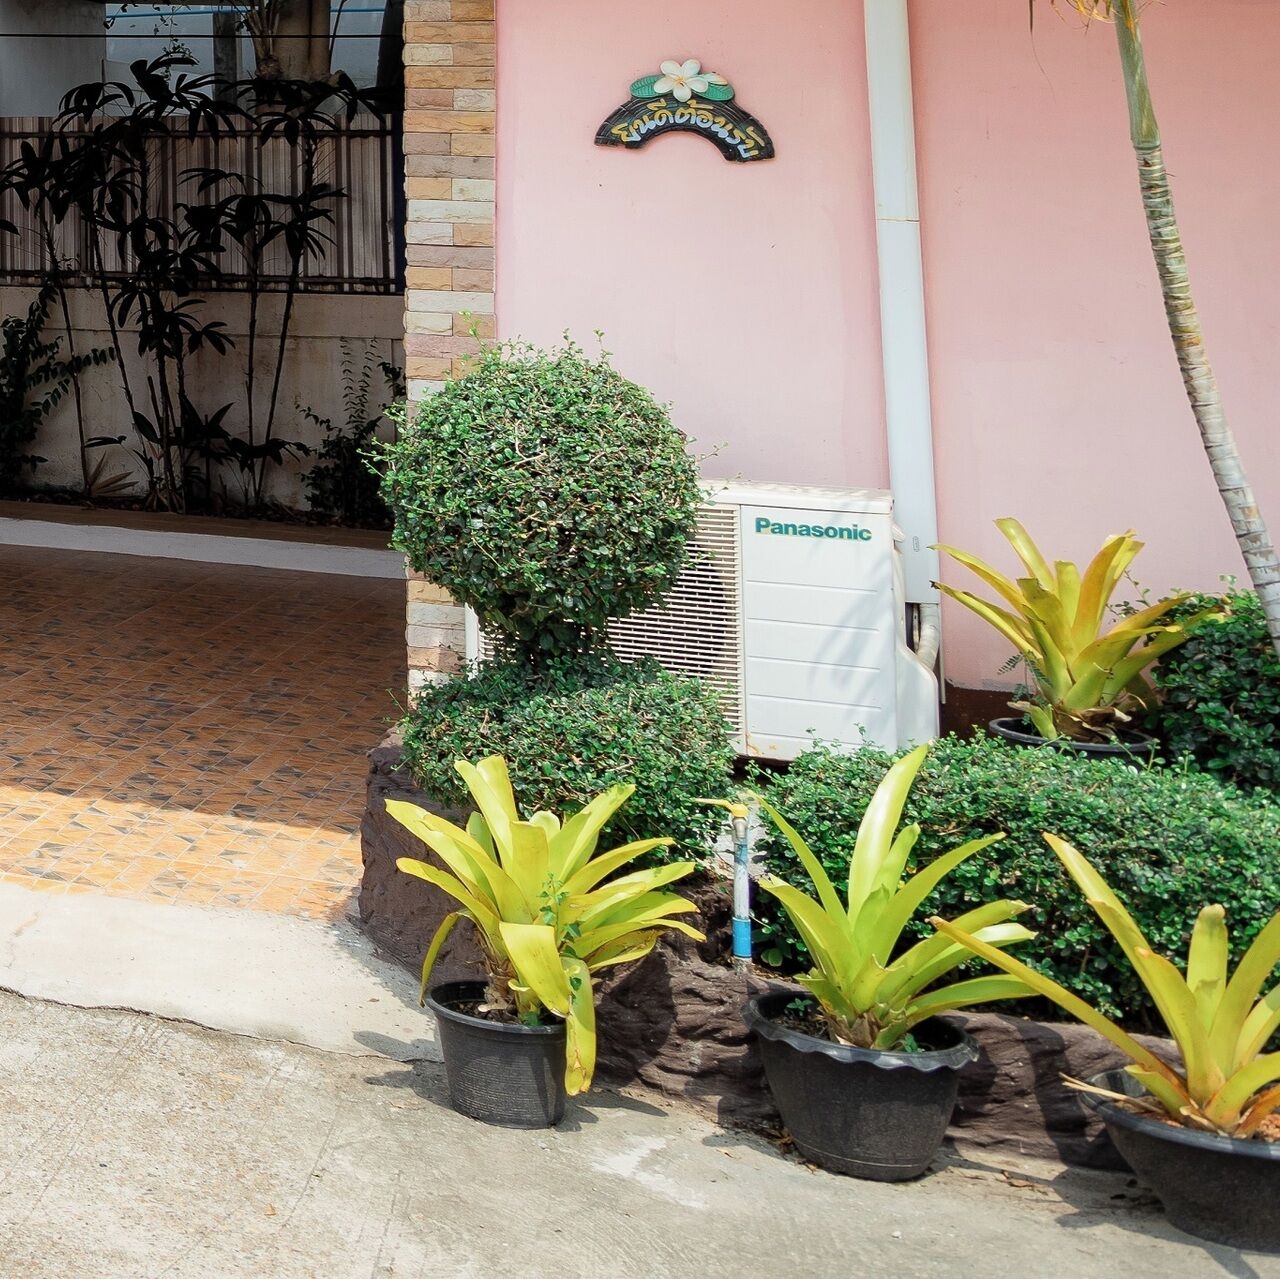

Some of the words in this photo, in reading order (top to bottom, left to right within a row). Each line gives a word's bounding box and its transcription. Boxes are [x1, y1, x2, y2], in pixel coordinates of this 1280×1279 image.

[611, 99, 765, 158] ยินดีต้อนรับ
[755, 517, 872, 541] Panasonic
